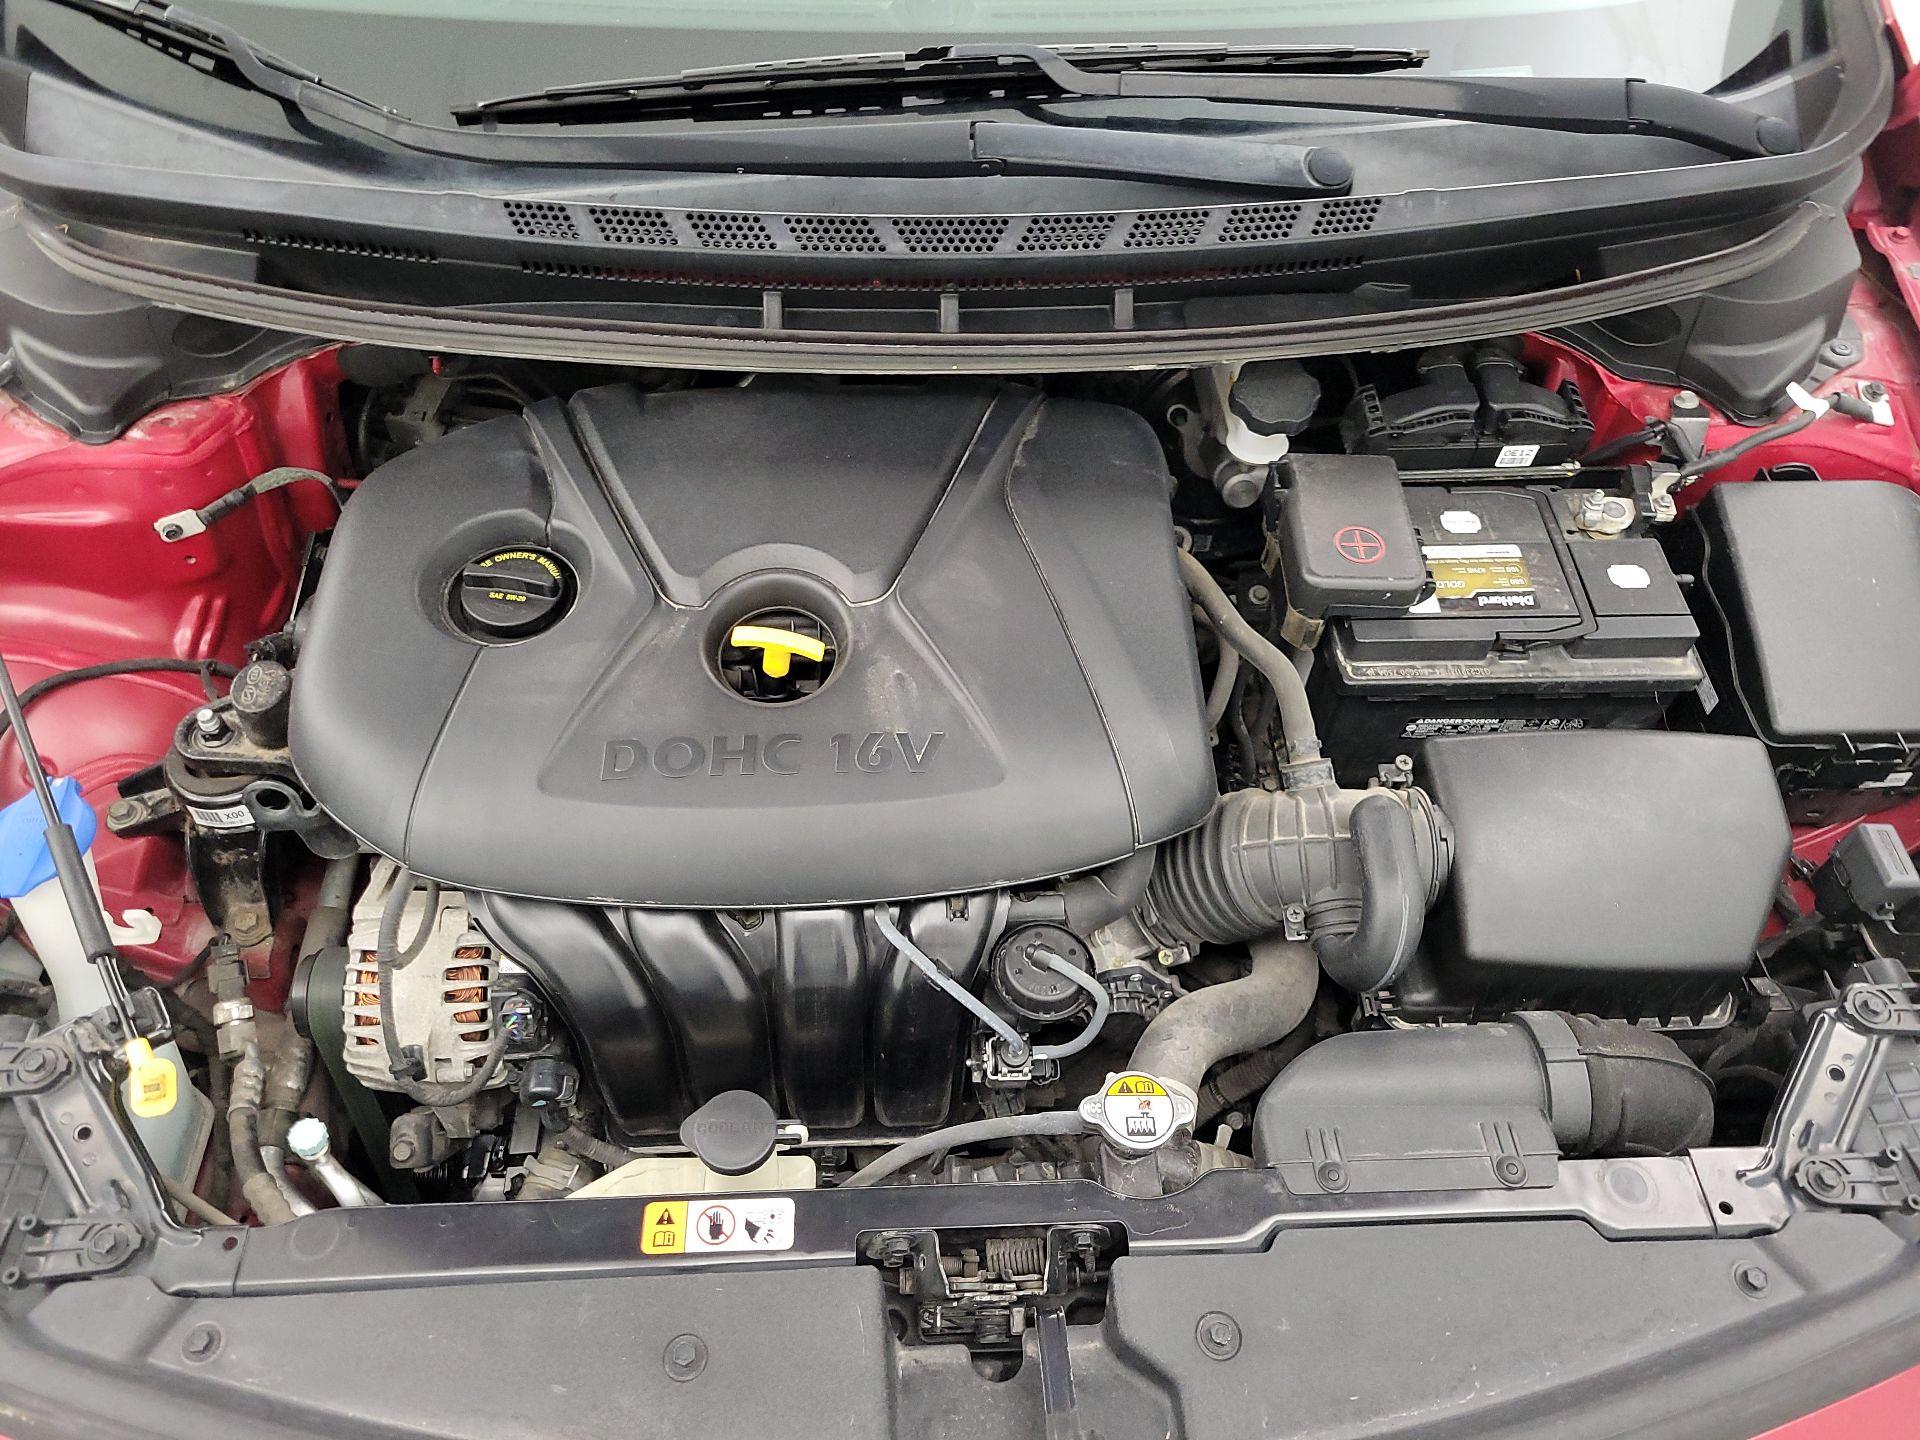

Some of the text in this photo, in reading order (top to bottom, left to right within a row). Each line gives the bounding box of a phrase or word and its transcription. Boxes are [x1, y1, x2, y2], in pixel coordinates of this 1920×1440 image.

[494, 551, 538, 563] OWNER'S
[1435, 580, 1466, 589] GOLD
[488, 591, 505, 600] SAE
[1477, 595, 1536, 607] DieHard
[599, 730, 947, 782] DOHC 16V
